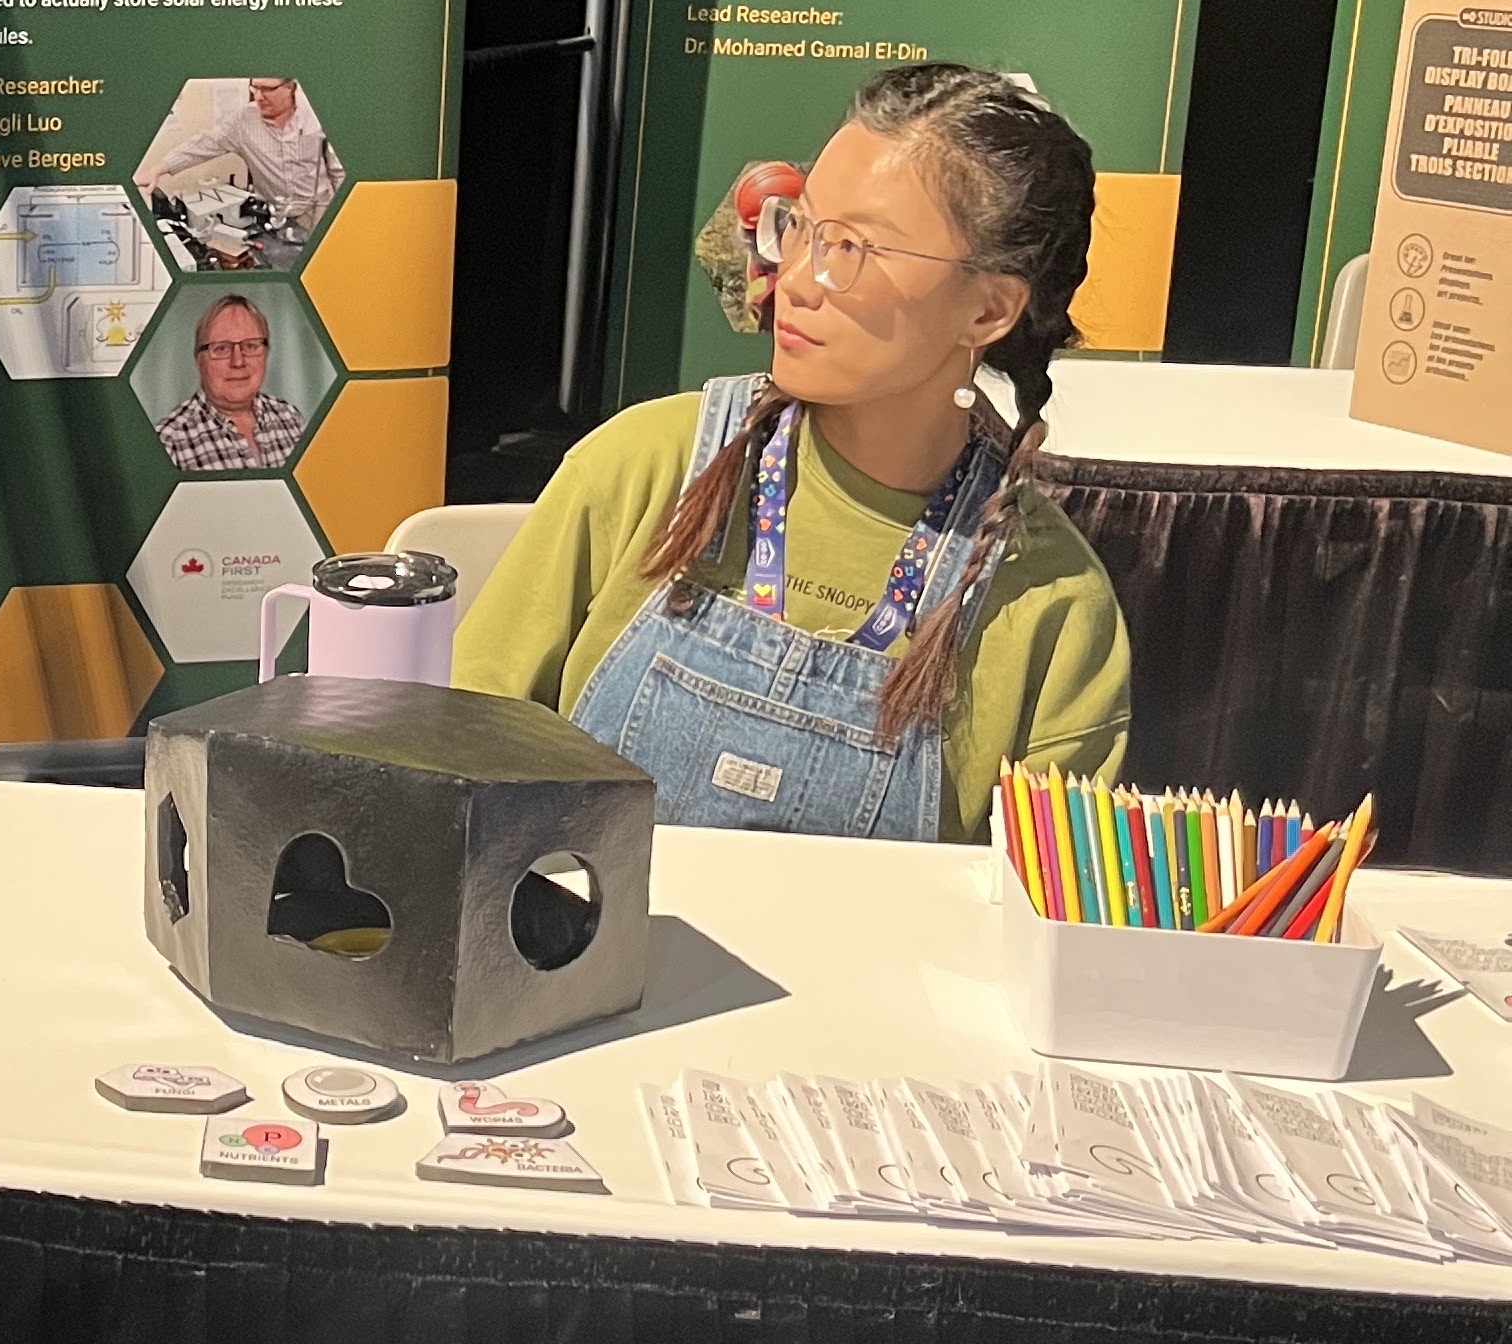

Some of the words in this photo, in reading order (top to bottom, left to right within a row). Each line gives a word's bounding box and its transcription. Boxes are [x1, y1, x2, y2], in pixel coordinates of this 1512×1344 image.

[687, 4, 732, 21] Lead
[684, 37, 706, 54] Dr.
[712, 37, 806, 57] Mohamed
[810, 40, 870, 58] Gamal
[1424, 66, 1486, 89] DISPLAY
[1443, 94, 1512, 119] PANNEAU
[27, 113, 62, 131] Luo
[1424, 114, 1512, 142] D'EXPOSITIO
[1442, 137, 1499, 160] PLIABLE
[28, 149, 105, 172] Bergens
[1410, 153, 1453, 176] TROIS
[221, 555, 281, 566] CANADA
[221, 566, 261, 577] FIRST
[786, 574, 813, 595] THE
[816, 585, 876, 615] SNOOPY
[318, 1098, 371, 1106] METALS
[470, 1116, 523, 1124] WORMS
[264, 1131, 282, 1143] P
[219, 1151, 299, 1165] NUTRIENTS
[517, 1163, 583, 1174] BACTERIA
